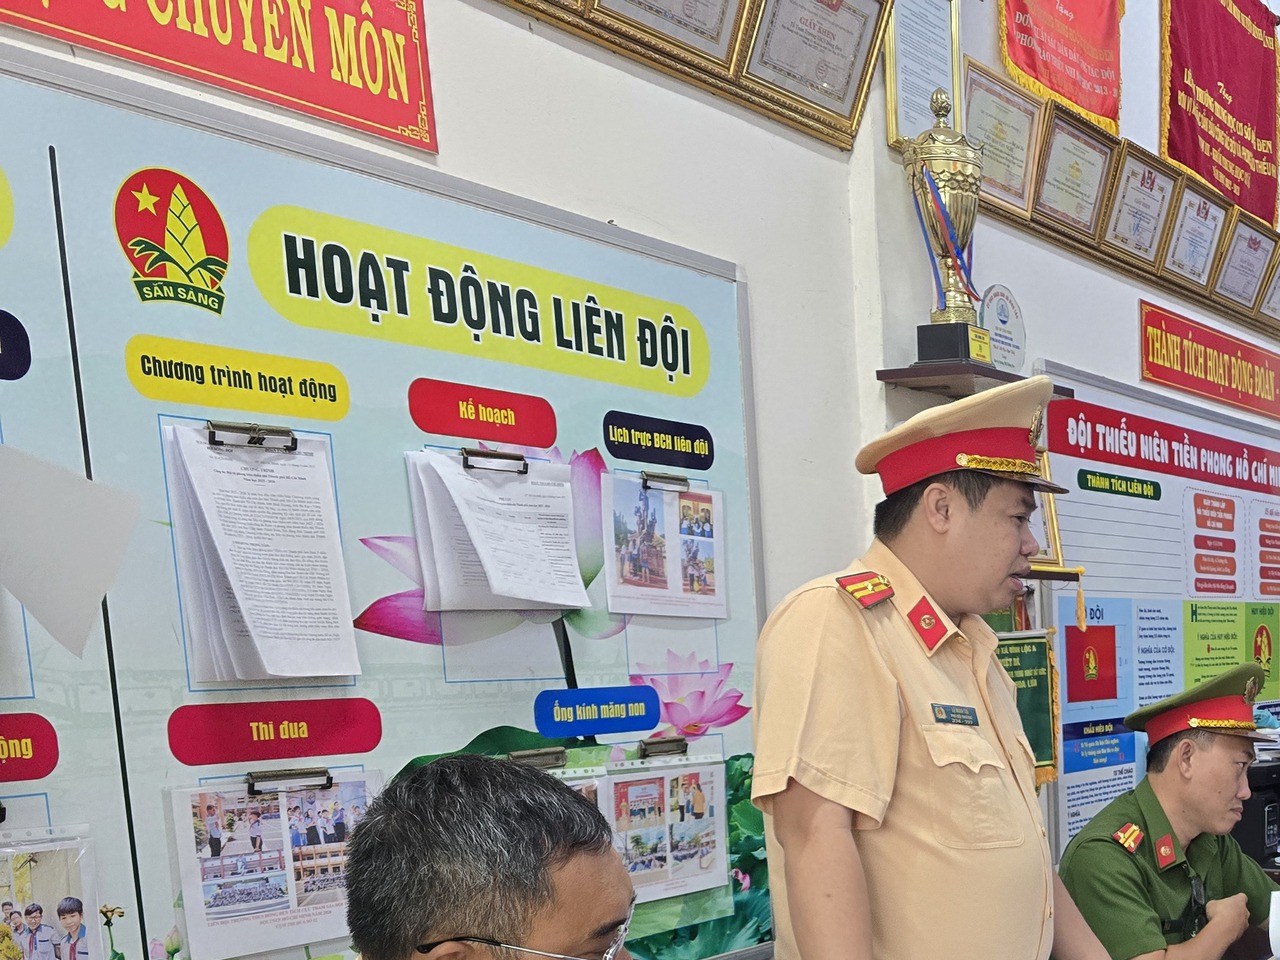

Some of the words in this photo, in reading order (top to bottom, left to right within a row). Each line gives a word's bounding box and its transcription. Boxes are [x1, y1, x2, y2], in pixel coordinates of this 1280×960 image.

[324, 0, 409, 104] MÔN
[177, 286, 219, 309] SÀNG
[283, 233, 410, 323] HOẠT
[428, 263, 541, 342] ĐỘNG
[552, 295, 626, 361] LIÊN
[637, 315, 691, 382] ĐỘI
[1147, 320, 1181, 372] THÀNH
[1183, 331, 1205, 379] TÍCH
[1207, 347, 1229, 393] HOẠT
[1231, 350, 1253, 399] ĐỘNG
[1255, 360, 1275, 401] ĐOÀN
[141, 354, 205, 385] Chương
[210, 365, 252, 390] trình
[258, 371, 293, 397] hoạt
[299, 380, 337, 402] động
[458, 398, 476, 421] Kế
[478, 403, 515, 427] hoạch
[609, 425, 629, 444] Lịch
[631, 428, 652, 448] trực
[653, 434, 672, 450] BCH
[674, 435, 691, 454] liên
[693, 439, 709, 456] đội
[1066, 413, 1092, 455] ĐỘI
[1096, 417, 1137, 458] THIẾU
[1140, 430, 1169, 464] NIÊN
[1171, 432, 1198, 470] TIỀN
[1200, 449, 1233, 478] PHONG
[1235, 449, 1250, 482] HỒ
[1252, 456, 1267, 485] CHÍ
[1087, 472, 1109, 490] THÀNH
[1111, 475, 1127, 492] TÍCH
[1127, 479, 1142, 495] LIÊN
[1143, 482, 1154, 499] ĐỘI
[1090, 605, 1103, 623] ĐỘI
[553, 700, 574, 722] Ống
[576, 703, 598, 720] kính
[600, 702, 626, 719] măng
[628, 702, 645, 716] non
[249, 722, 274, 741] Thi
[279, 721, 308, 740] đua
